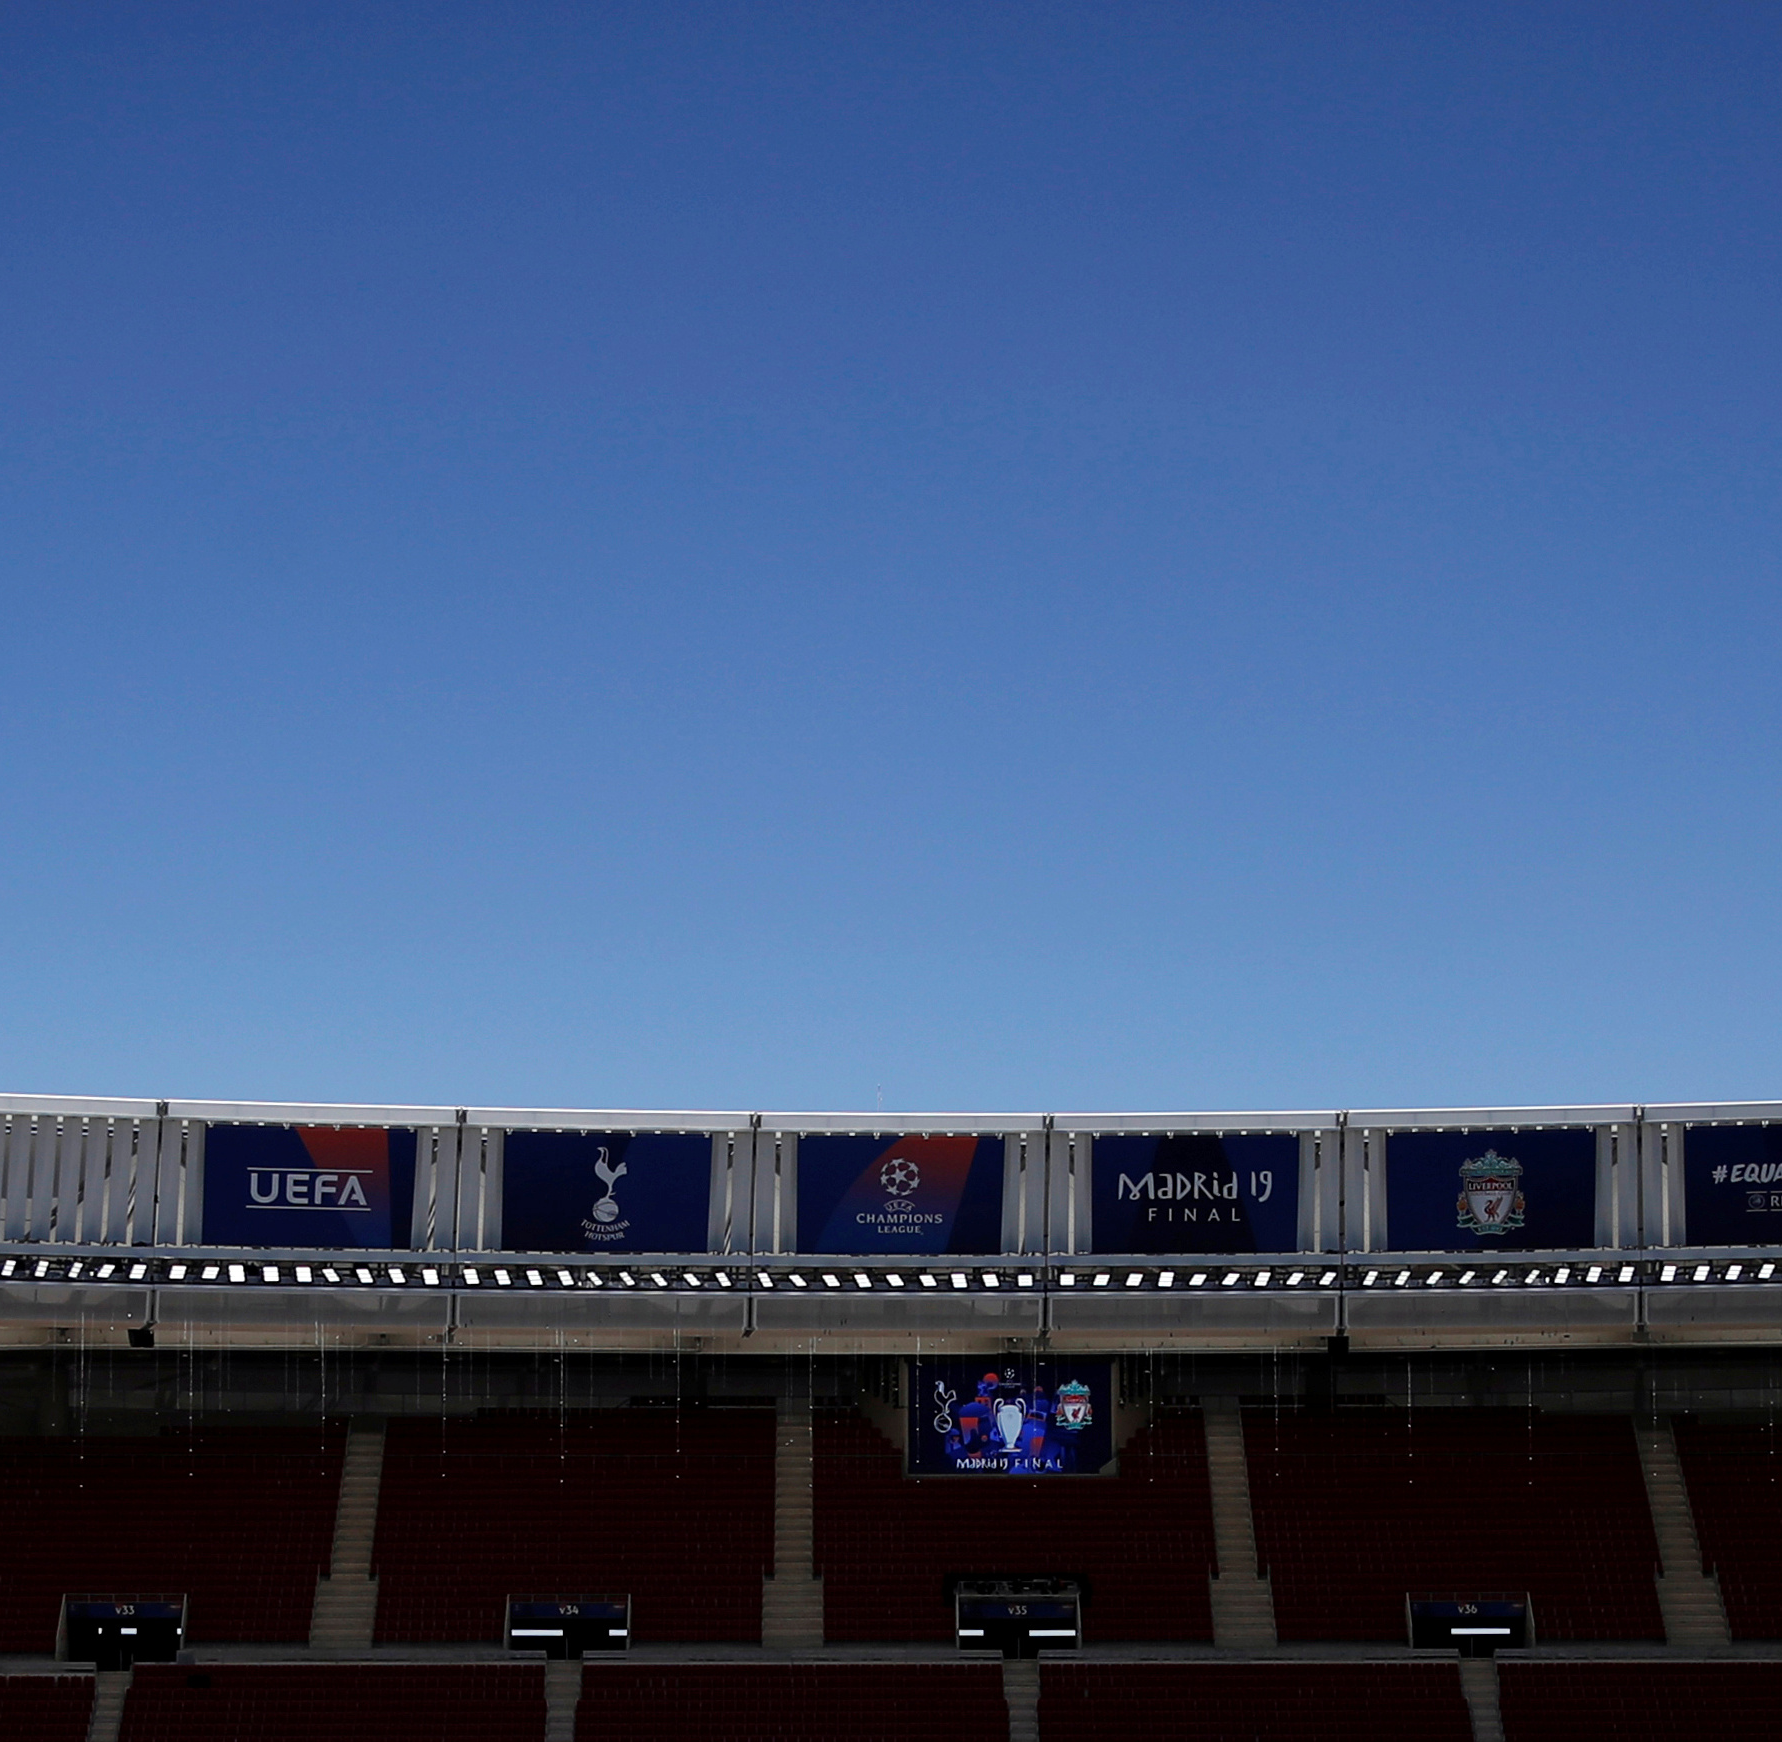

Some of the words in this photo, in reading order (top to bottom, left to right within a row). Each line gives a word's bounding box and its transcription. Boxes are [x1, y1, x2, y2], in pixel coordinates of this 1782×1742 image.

[249, 1172, 368, 1206] UEFA
[1250, 1170, 1273, 1203] 19
[1468, 1182, 1513, 1190] LIVERPOOL
[884, 1199, 913, 1211] UEFA
[855, 1213, 943, 1224] CHAMPIONS
[1147, 1207, 1241, 1222] FINAL
[580, 1218, 631, 1233] TOTTENHAM
[877, 1225, 922, 1234] LEAGUE
[584, 1230, 626, 1241] HOTSPUR
[999, 1458, 1009, 1471] 19
[1014, 1457, 1064, 1470] FINAL
[114, 1604, 136, 1616] v33
[558, 1604, 580, 1616] v34
[1007, 1604, 1028, 1616] v35
[1456, 1603, 1478, 1615] v36
